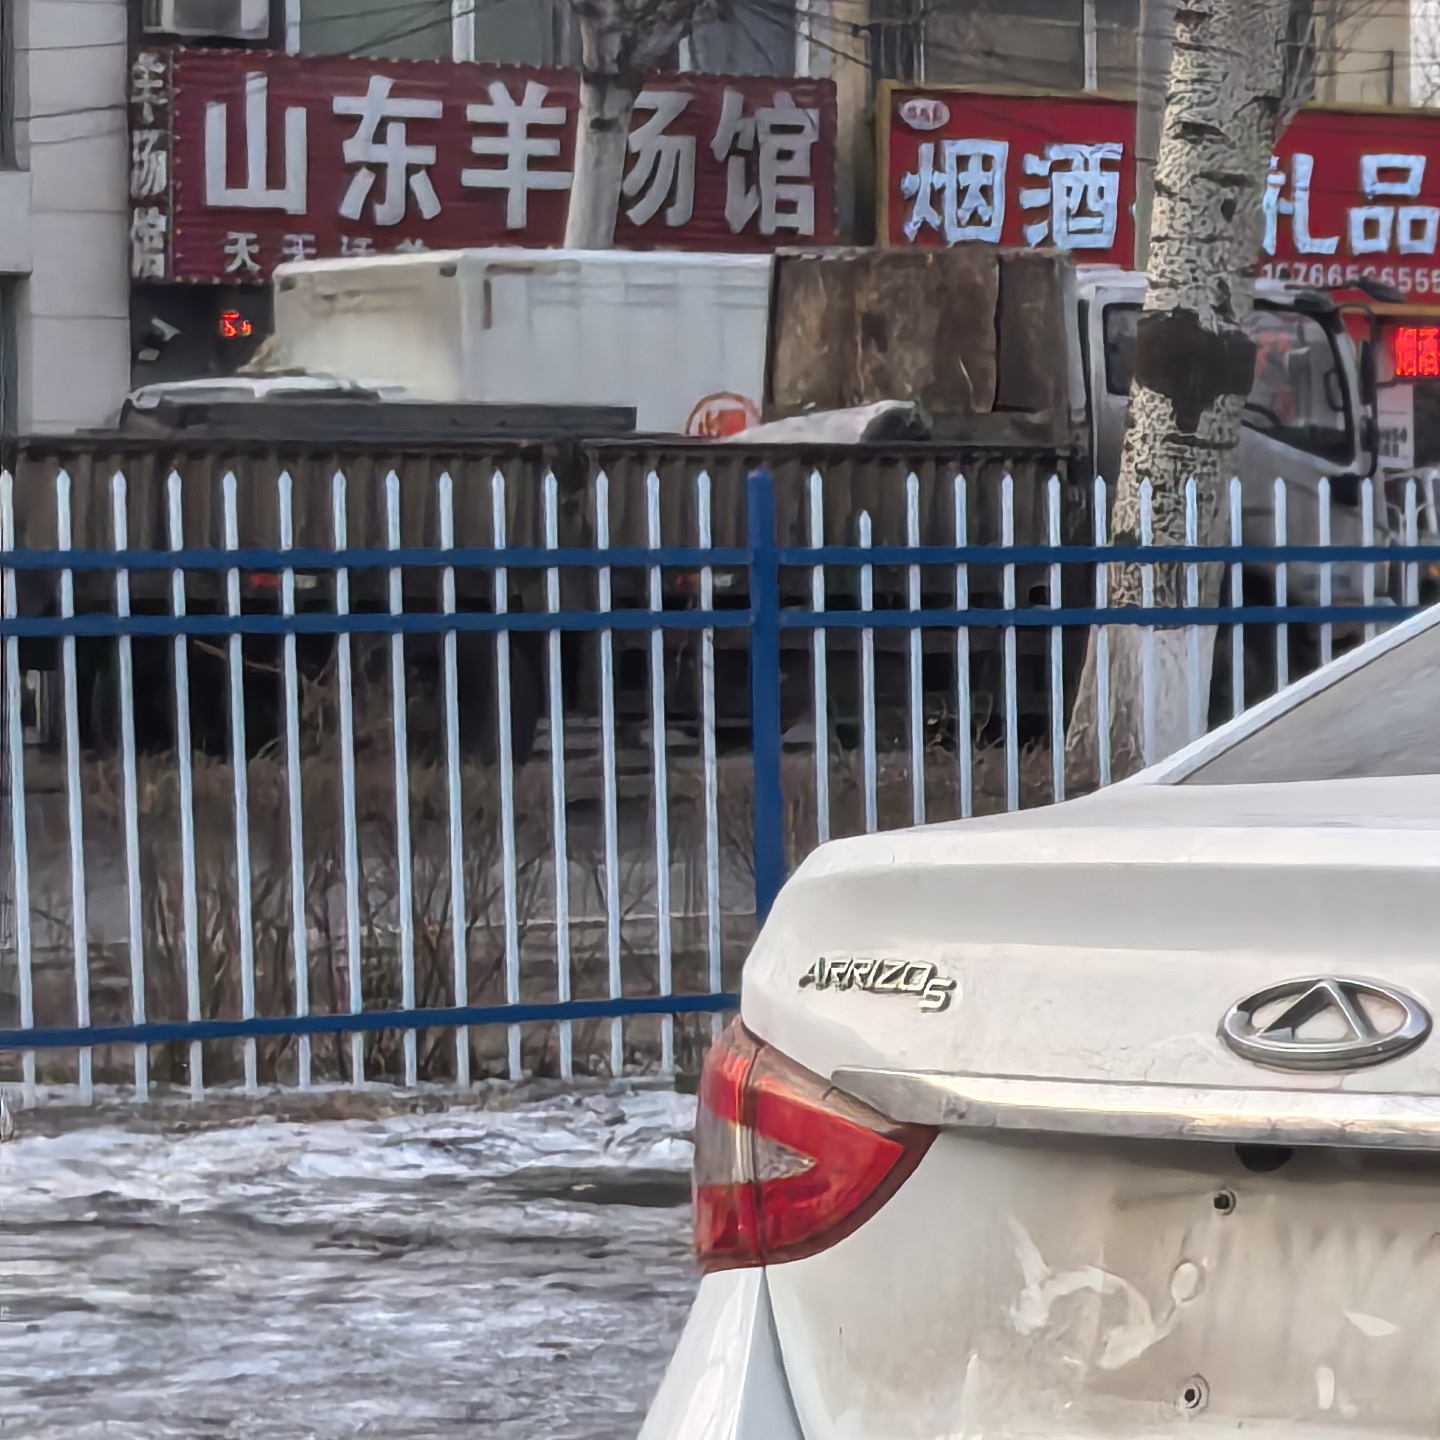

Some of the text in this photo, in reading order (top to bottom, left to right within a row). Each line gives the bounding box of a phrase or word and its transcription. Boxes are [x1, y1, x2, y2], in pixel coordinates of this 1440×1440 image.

[205, 71, 820, 236] 山东羊汤馆
